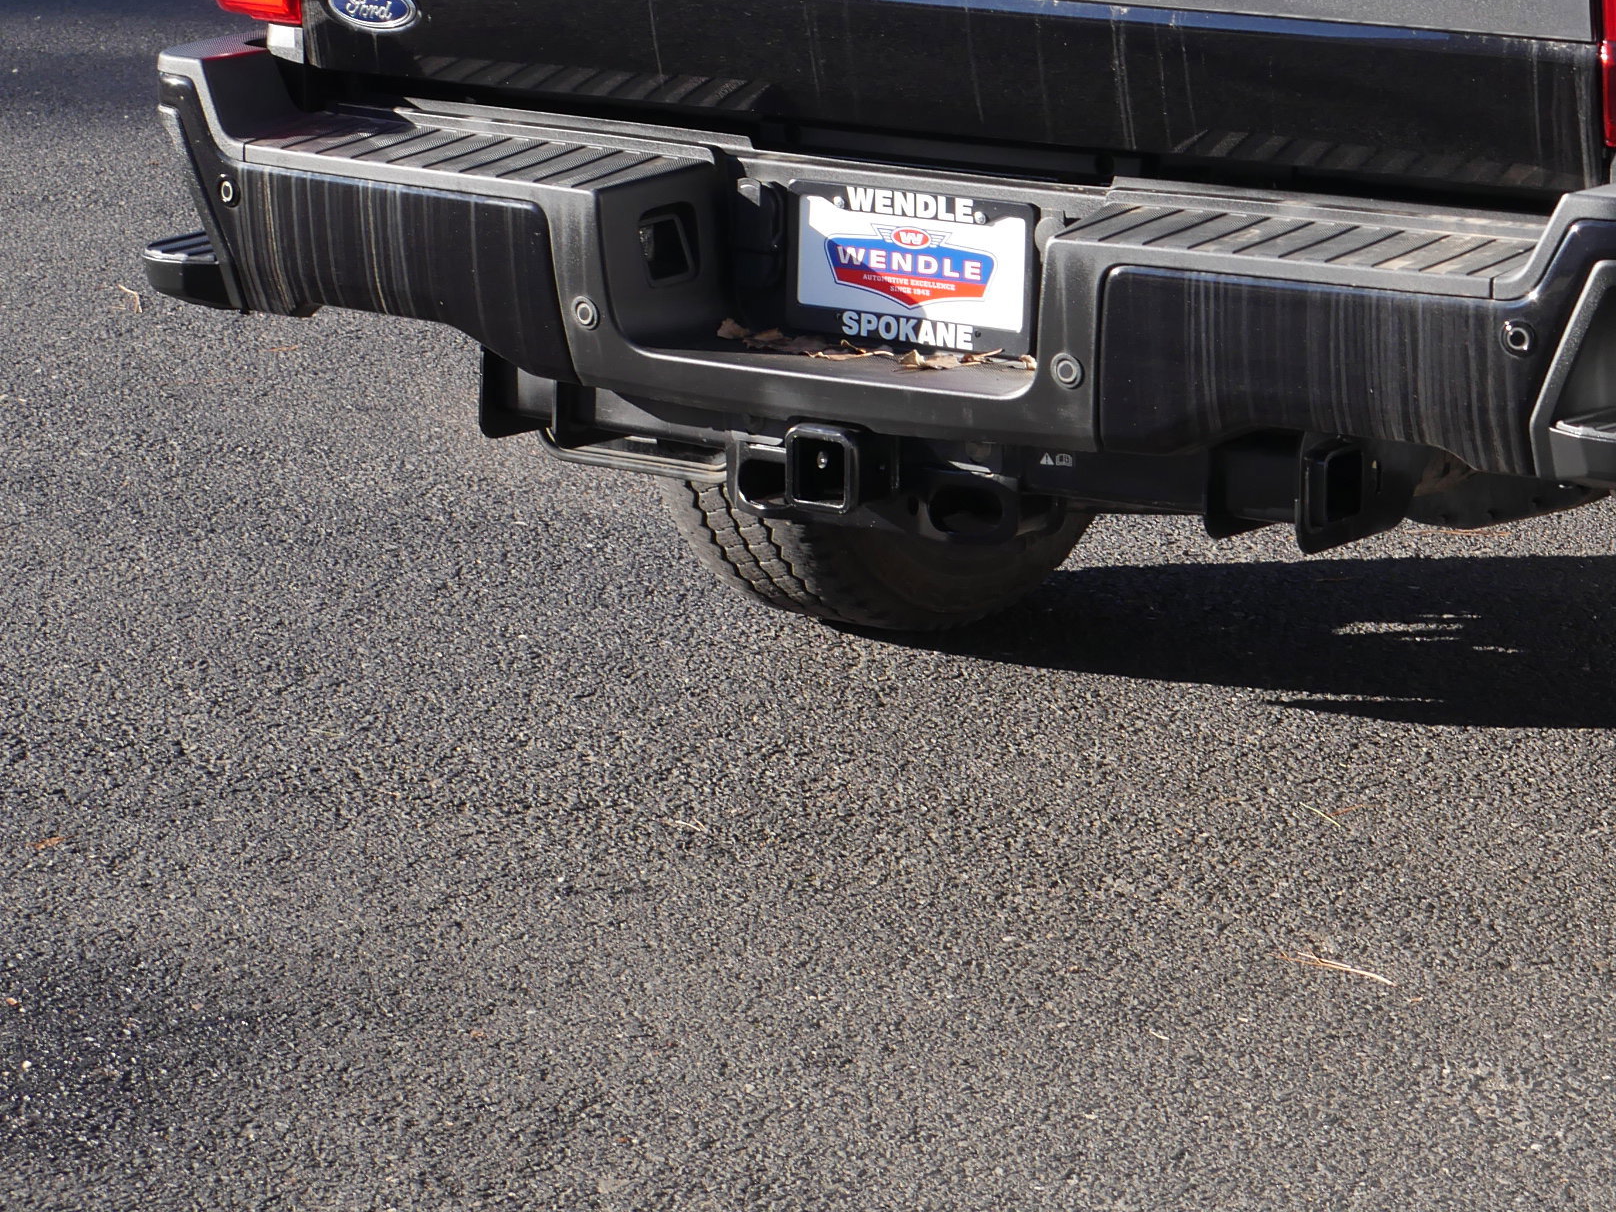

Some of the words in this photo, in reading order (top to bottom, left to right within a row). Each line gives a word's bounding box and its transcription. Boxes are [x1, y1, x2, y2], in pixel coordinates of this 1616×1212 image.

[846, 186, 974, 224] WENDLE
[836, 244, 982, 281] WENDLE
[862, 273, 910, 286] AUTOMOTIVE
[910, 278, 956, 291] EXCELLENCE
[890, 286, 912, 295] SINCE
[841, 311, 974, 351] SPOKANE
